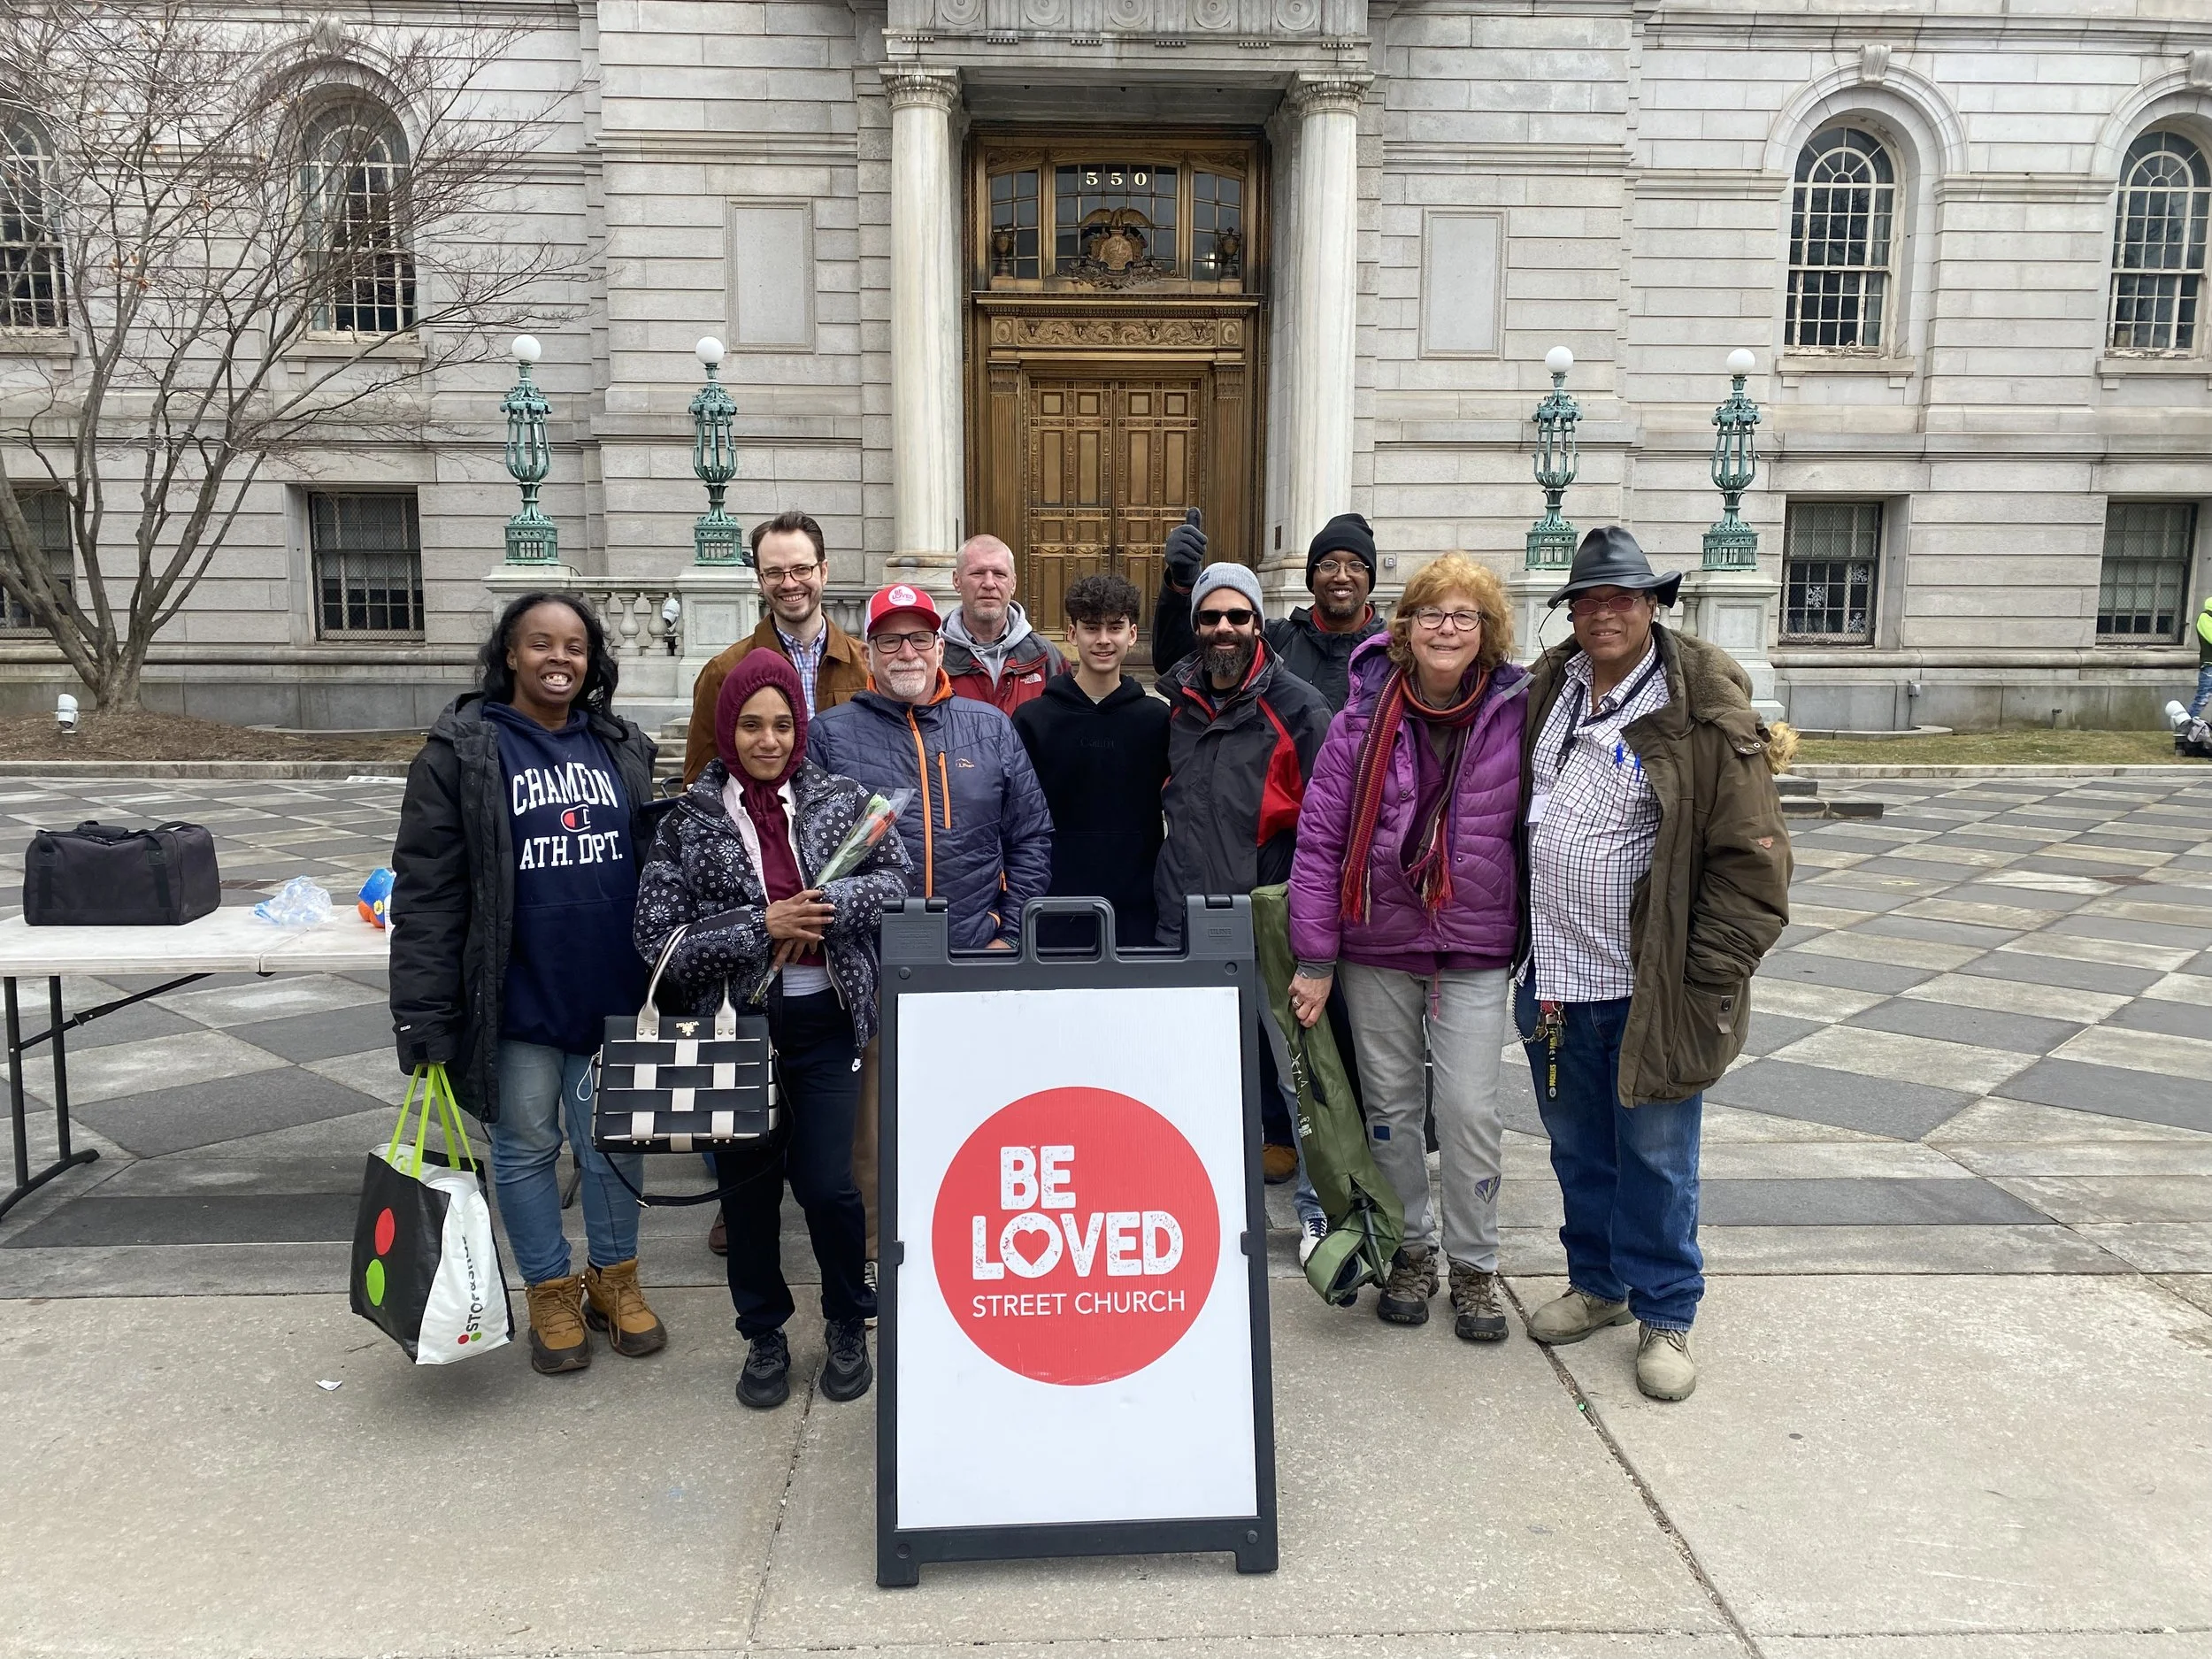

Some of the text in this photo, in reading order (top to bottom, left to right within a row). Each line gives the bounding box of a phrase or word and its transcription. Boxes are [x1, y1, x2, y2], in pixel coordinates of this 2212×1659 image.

[1086, 172, 1148, 186] 550
[519, 830, 624, 870] ATH. DPT.
[1000, 1144, 1076, 1210] BE
[972, 1210, 1184, 1280] LOVED
[972, 1290, 1186, 1317] STREET CHURCH
